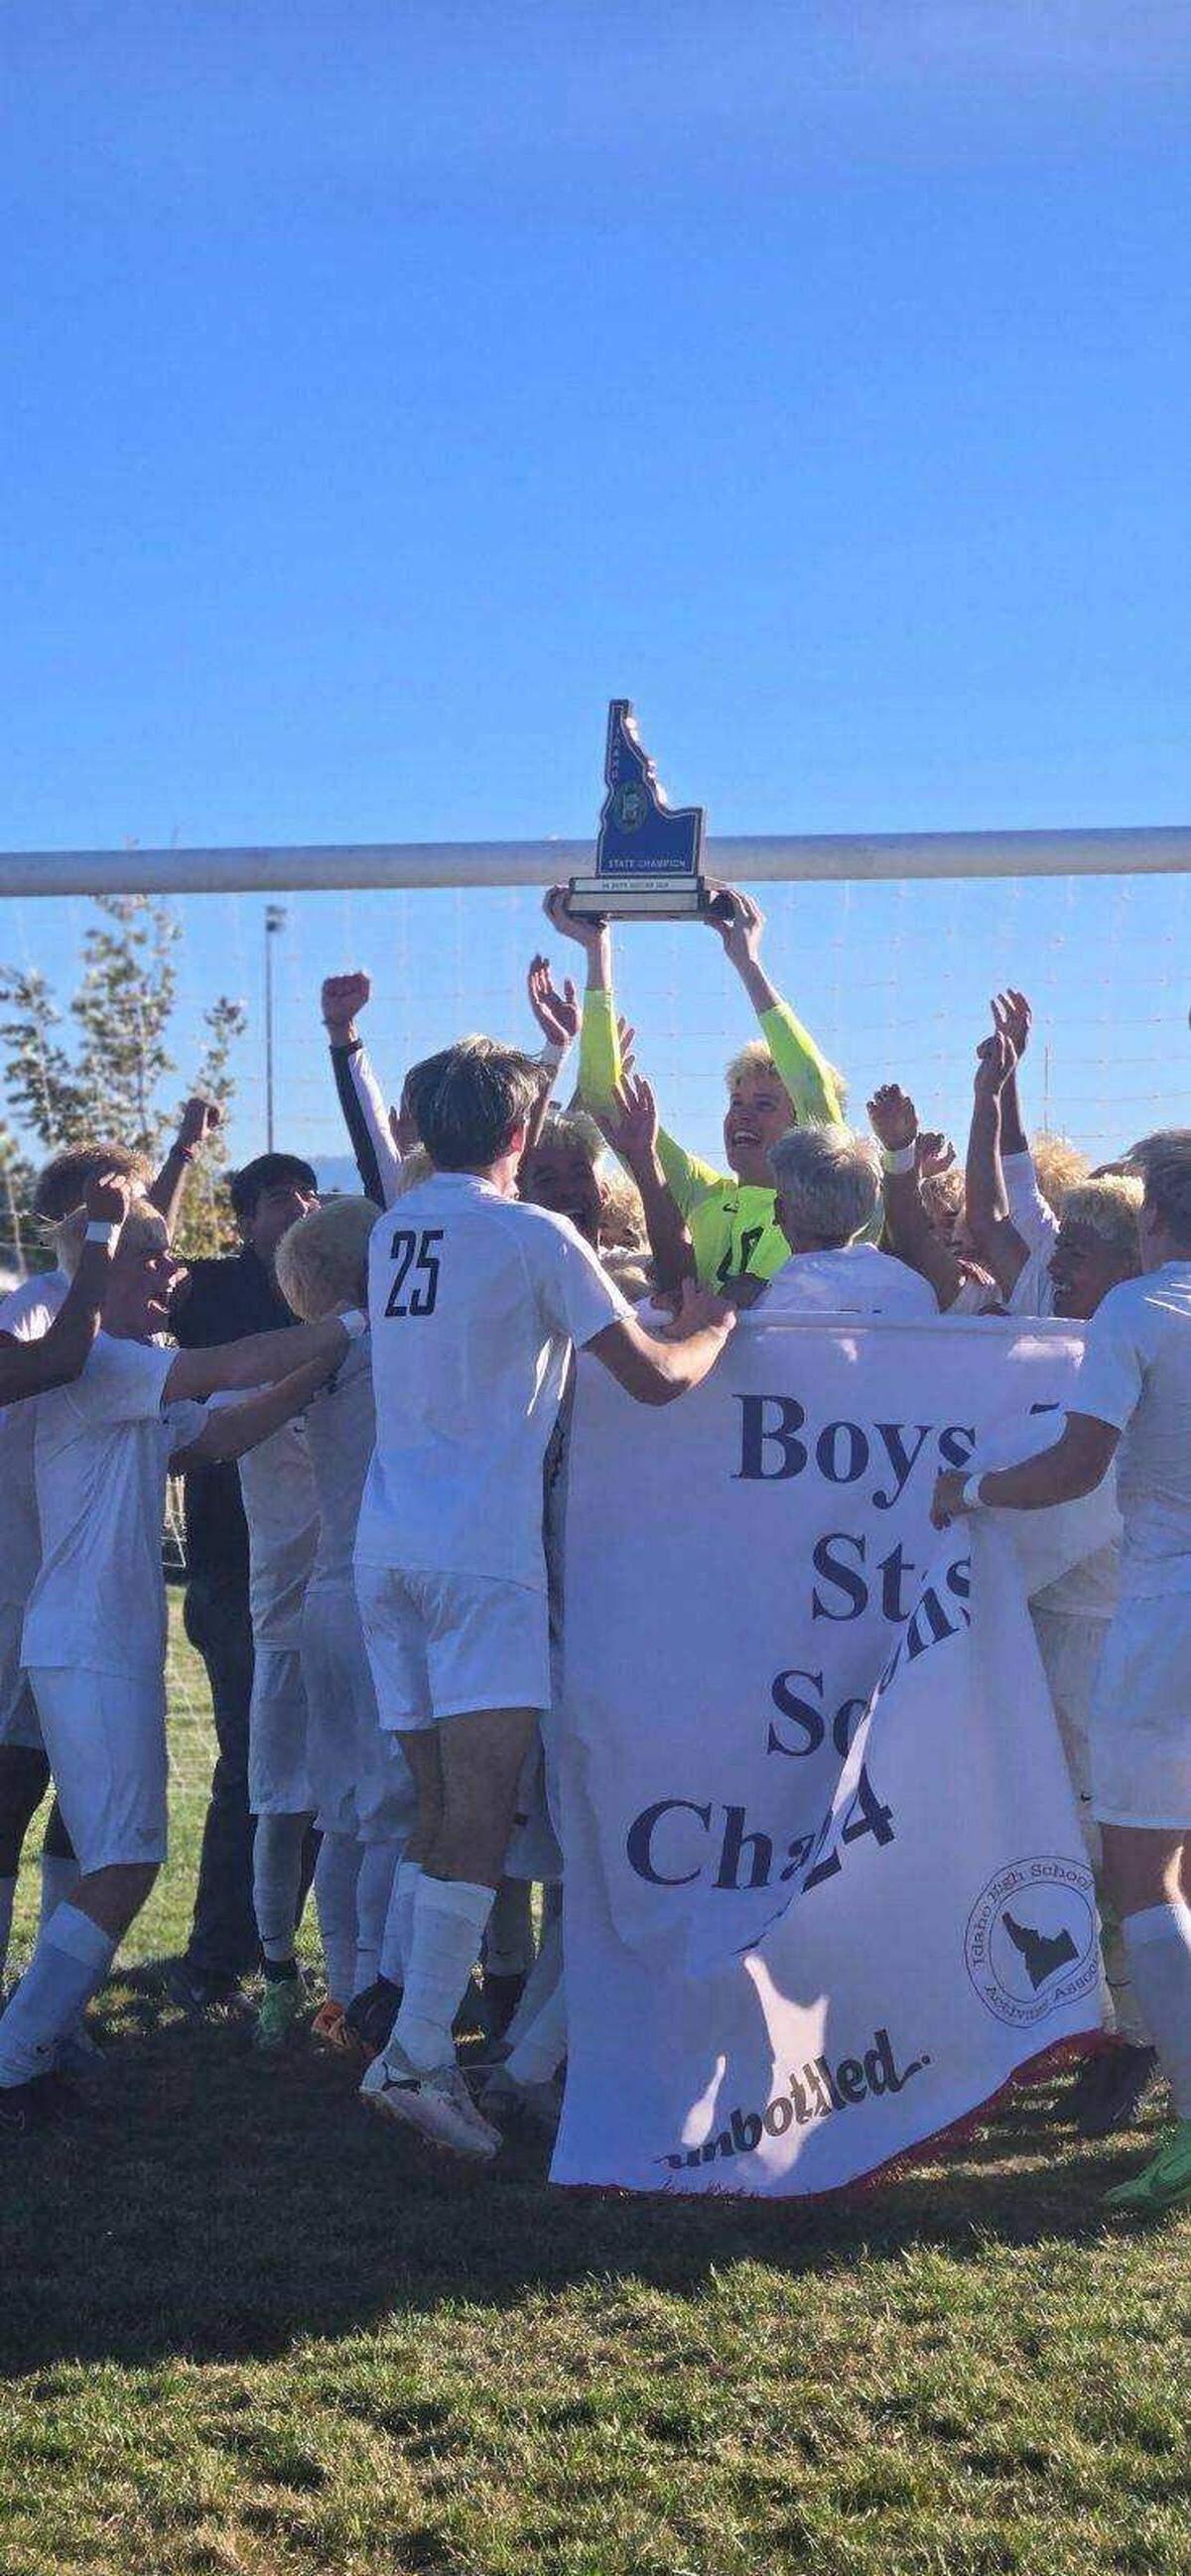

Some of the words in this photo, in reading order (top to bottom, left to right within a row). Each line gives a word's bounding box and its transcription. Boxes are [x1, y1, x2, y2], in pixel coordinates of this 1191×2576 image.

[608, 859, 634, 868] STATE
[636, 859, 686, 868] CHAMPION
[384, 1229, 444, 1317] 25
[730, 1393, 978, 1510] Boys
[811, 1533, 916, 1622] St
[767, 1669, 871, 1758] So
[626, 1799, 817, 1890] Cha
[972, 1905, 992, 1968] Idaho
[1030, 1864, 1095, 1891] School
